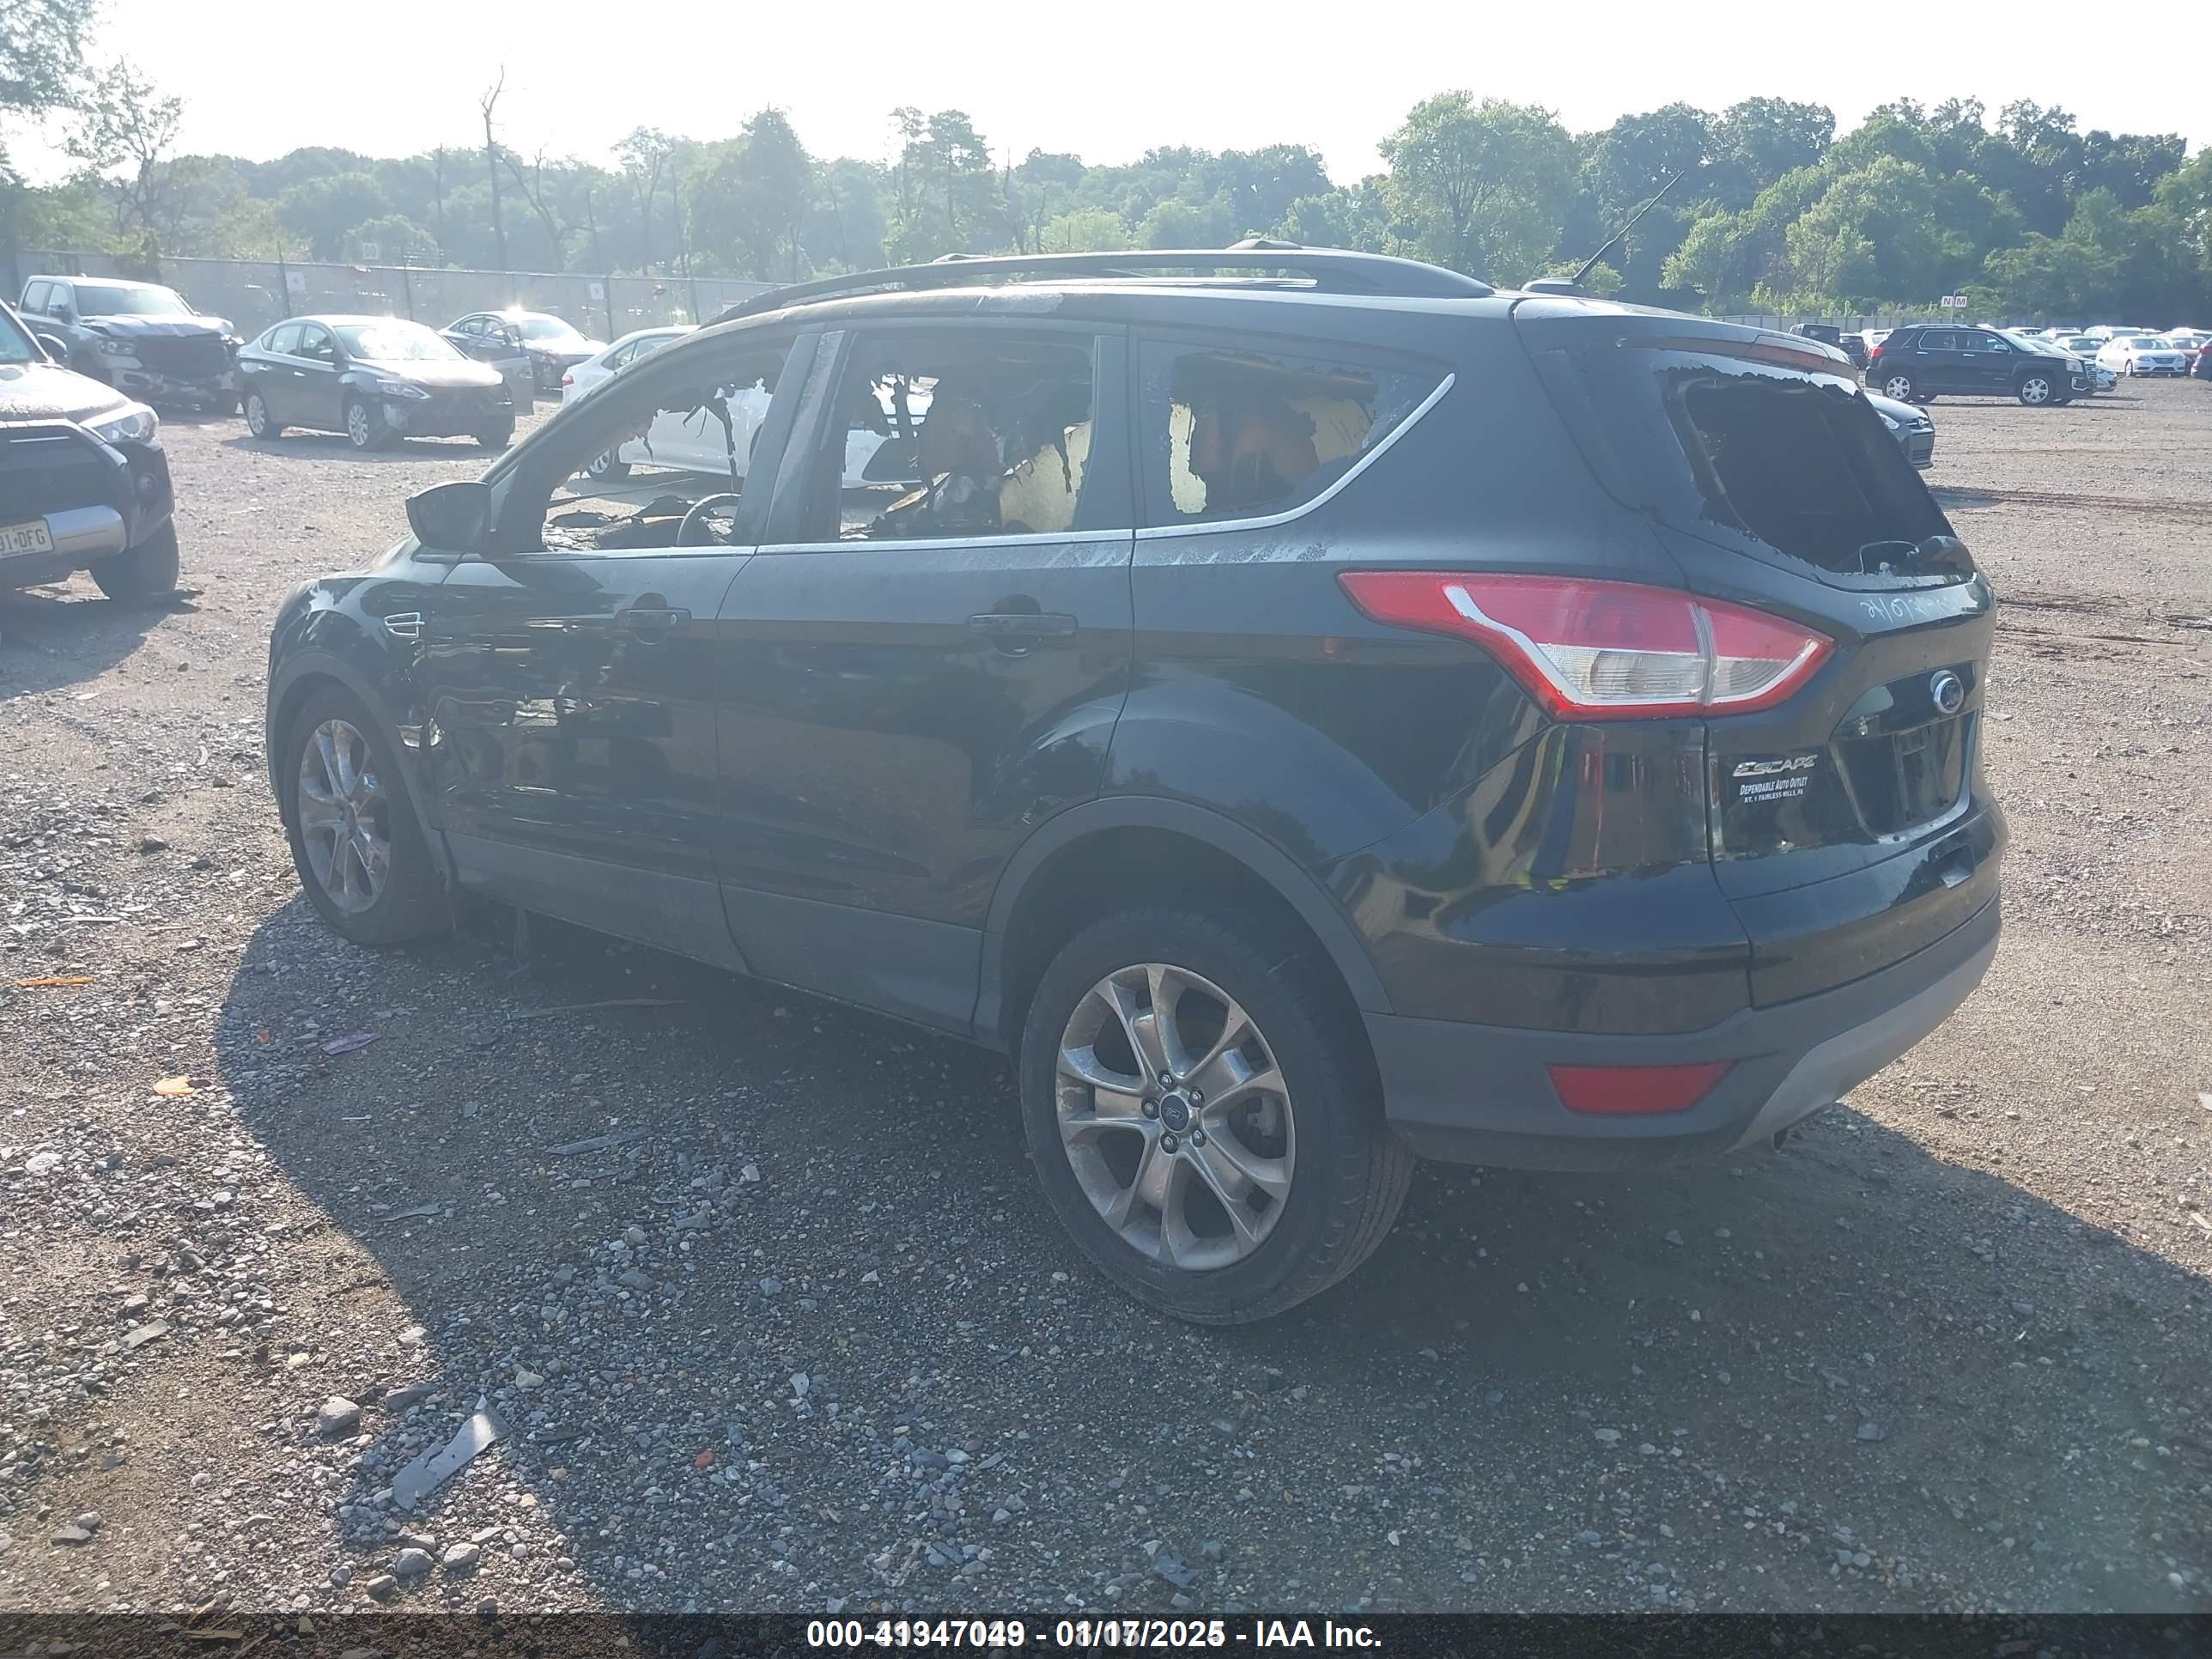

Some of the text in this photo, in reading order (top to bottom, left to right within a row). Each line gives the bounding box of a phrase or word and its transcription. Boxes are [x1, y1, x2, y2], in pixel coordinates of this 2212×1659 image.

[1957, 297, 1966, 306] M
[1733, 755, 1818, 777] ESCAPE
[1739, 776, 1808, 796] DEPENDABLE AUTO OUTLET
[1759, 791, 1782, 801] FAIRLESS
